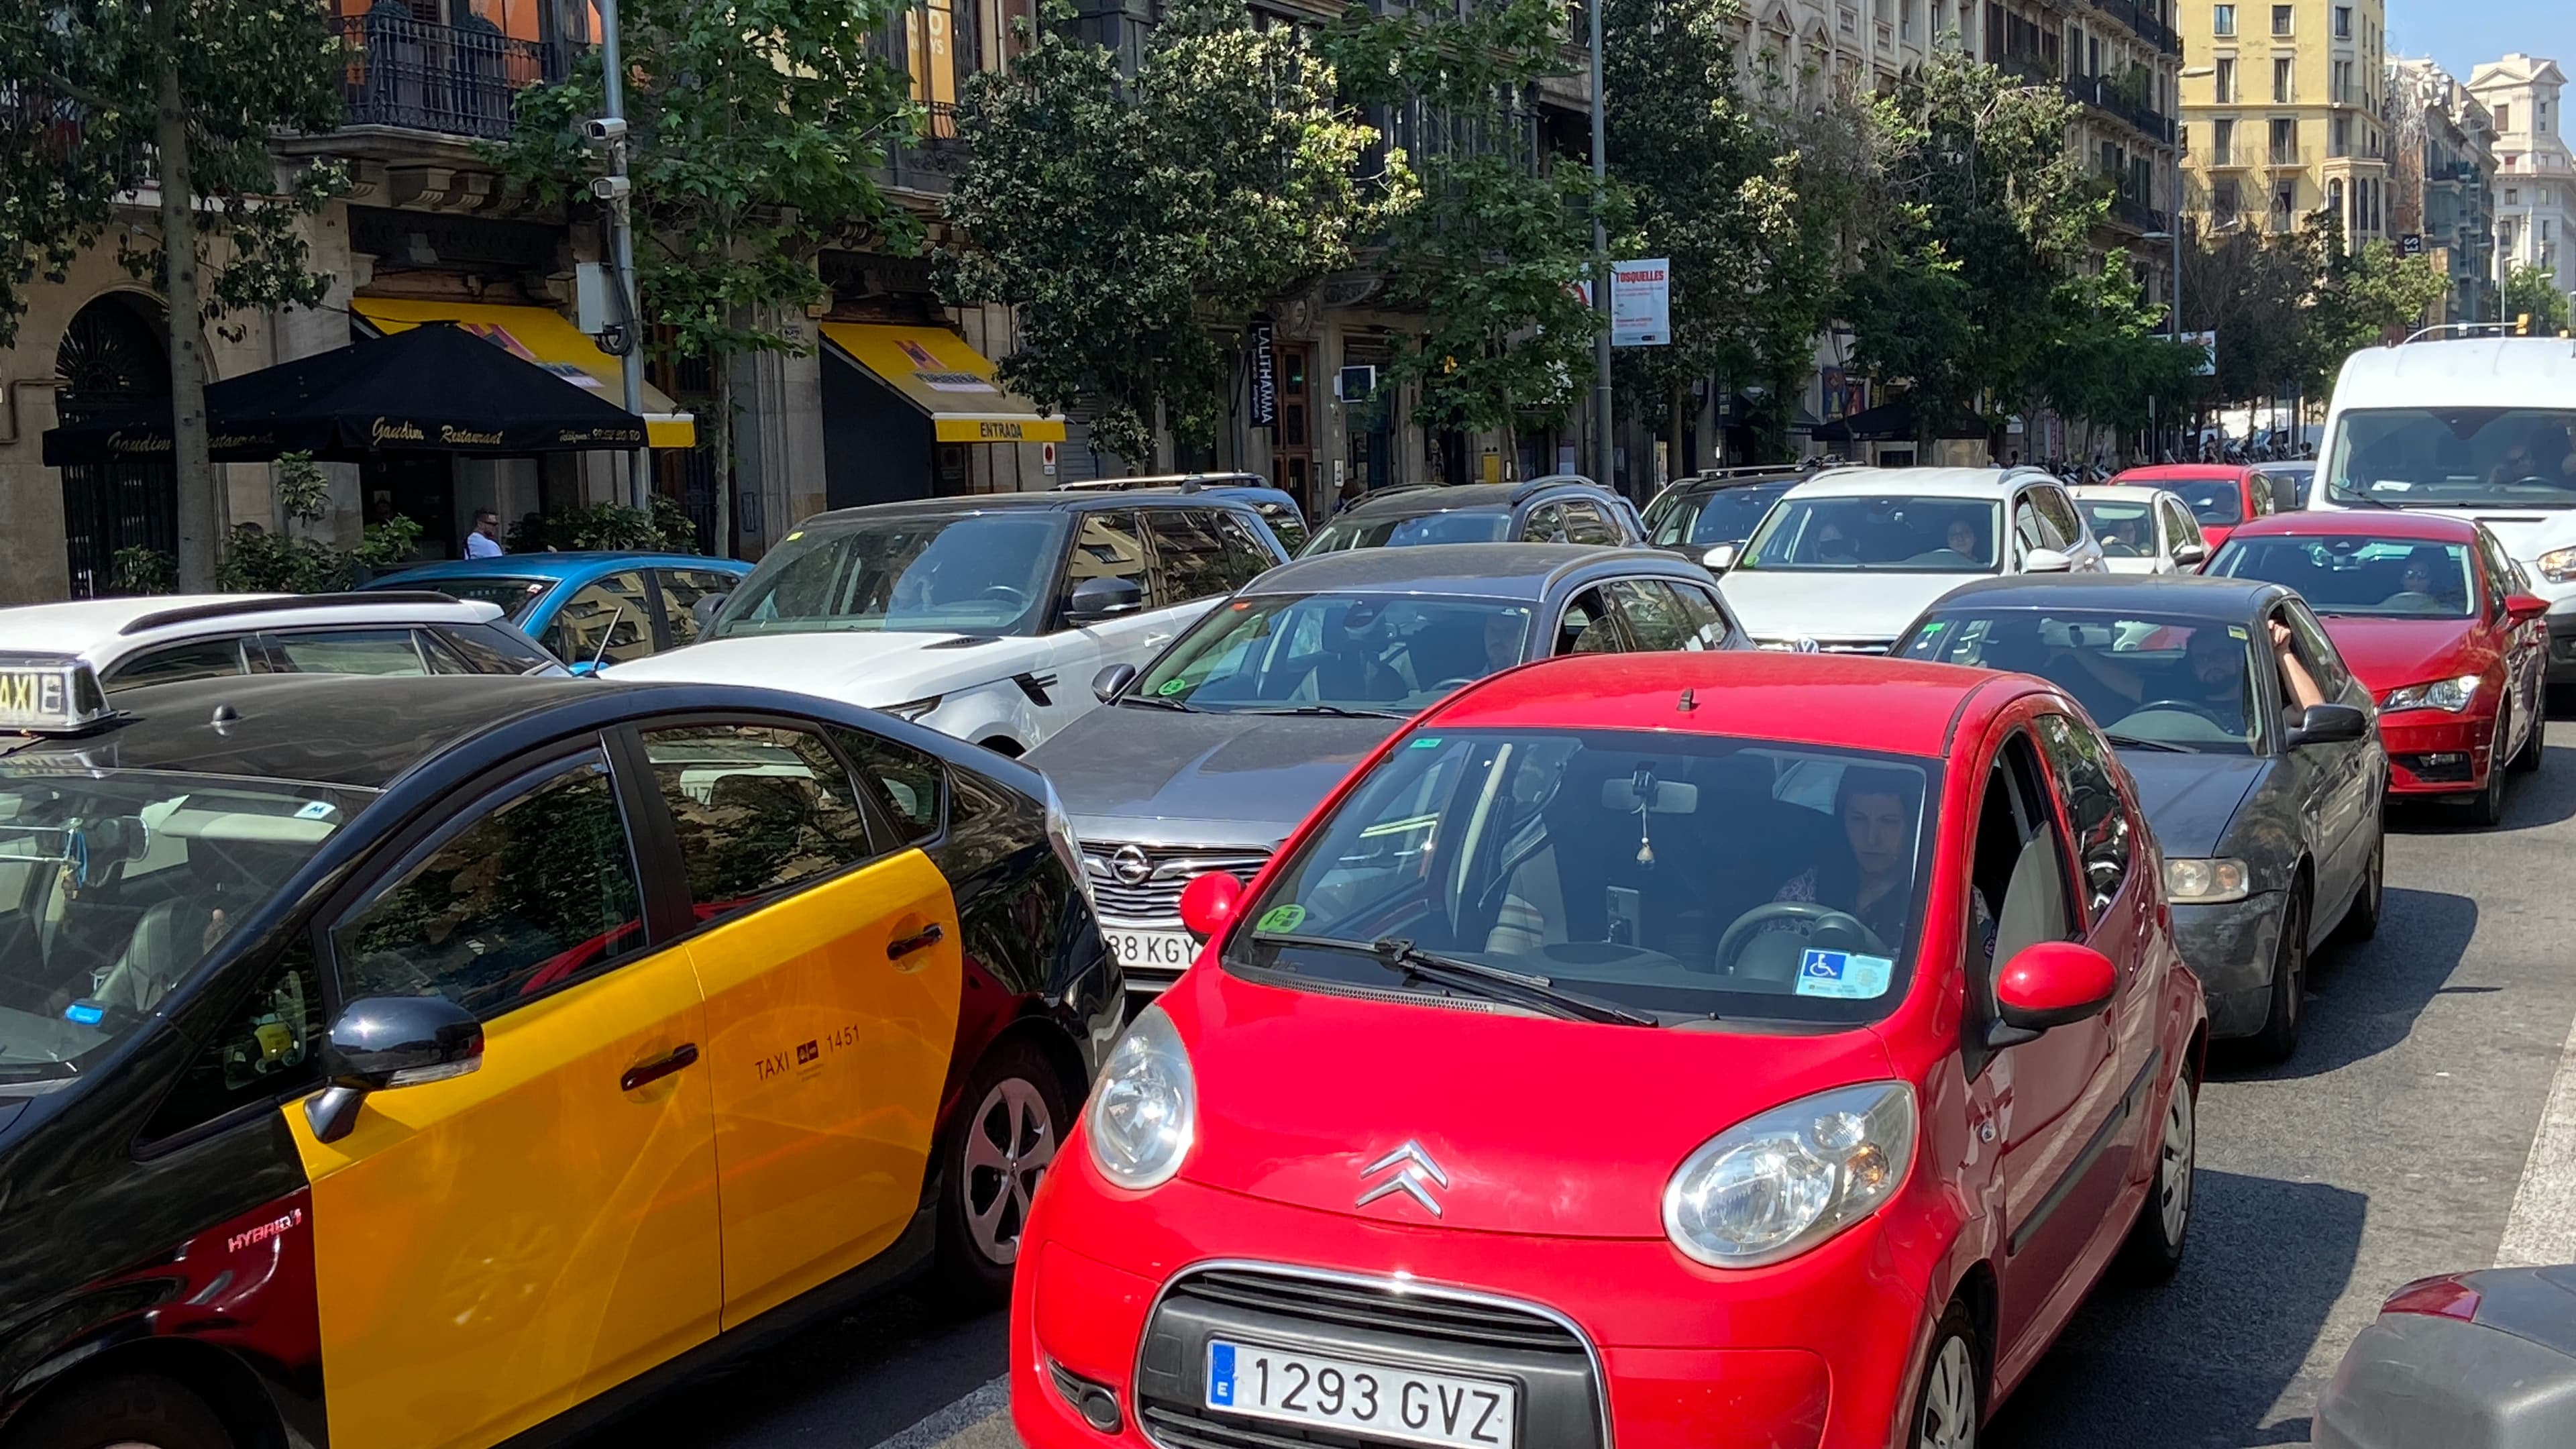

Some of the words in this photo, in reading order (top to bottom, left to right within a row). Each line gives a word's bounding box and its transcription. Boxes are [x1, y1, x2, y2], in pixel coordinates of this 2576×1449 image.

[1258, 327, 1273, 423] LALITHAMMA
[206, 433, 275, 448] estaurant
[372, 416, 425, 446] Gaudim
[439, 424, 503, 444] Restaurant
[979, 422, 1023, 439] ENTRADA
[1147, 936, 1197, 964] KGY
[755, 1051, 790, 1081] TAXI
[826, 1024, 860, 1053] 1451
[227, 1214, 292, 1253] HYBRID
[1216, 1381, 1229, 1397] E
[1255, 1358, 1379, 1421] 1293
[1401, 1380, 1501, 1444] GVZ
